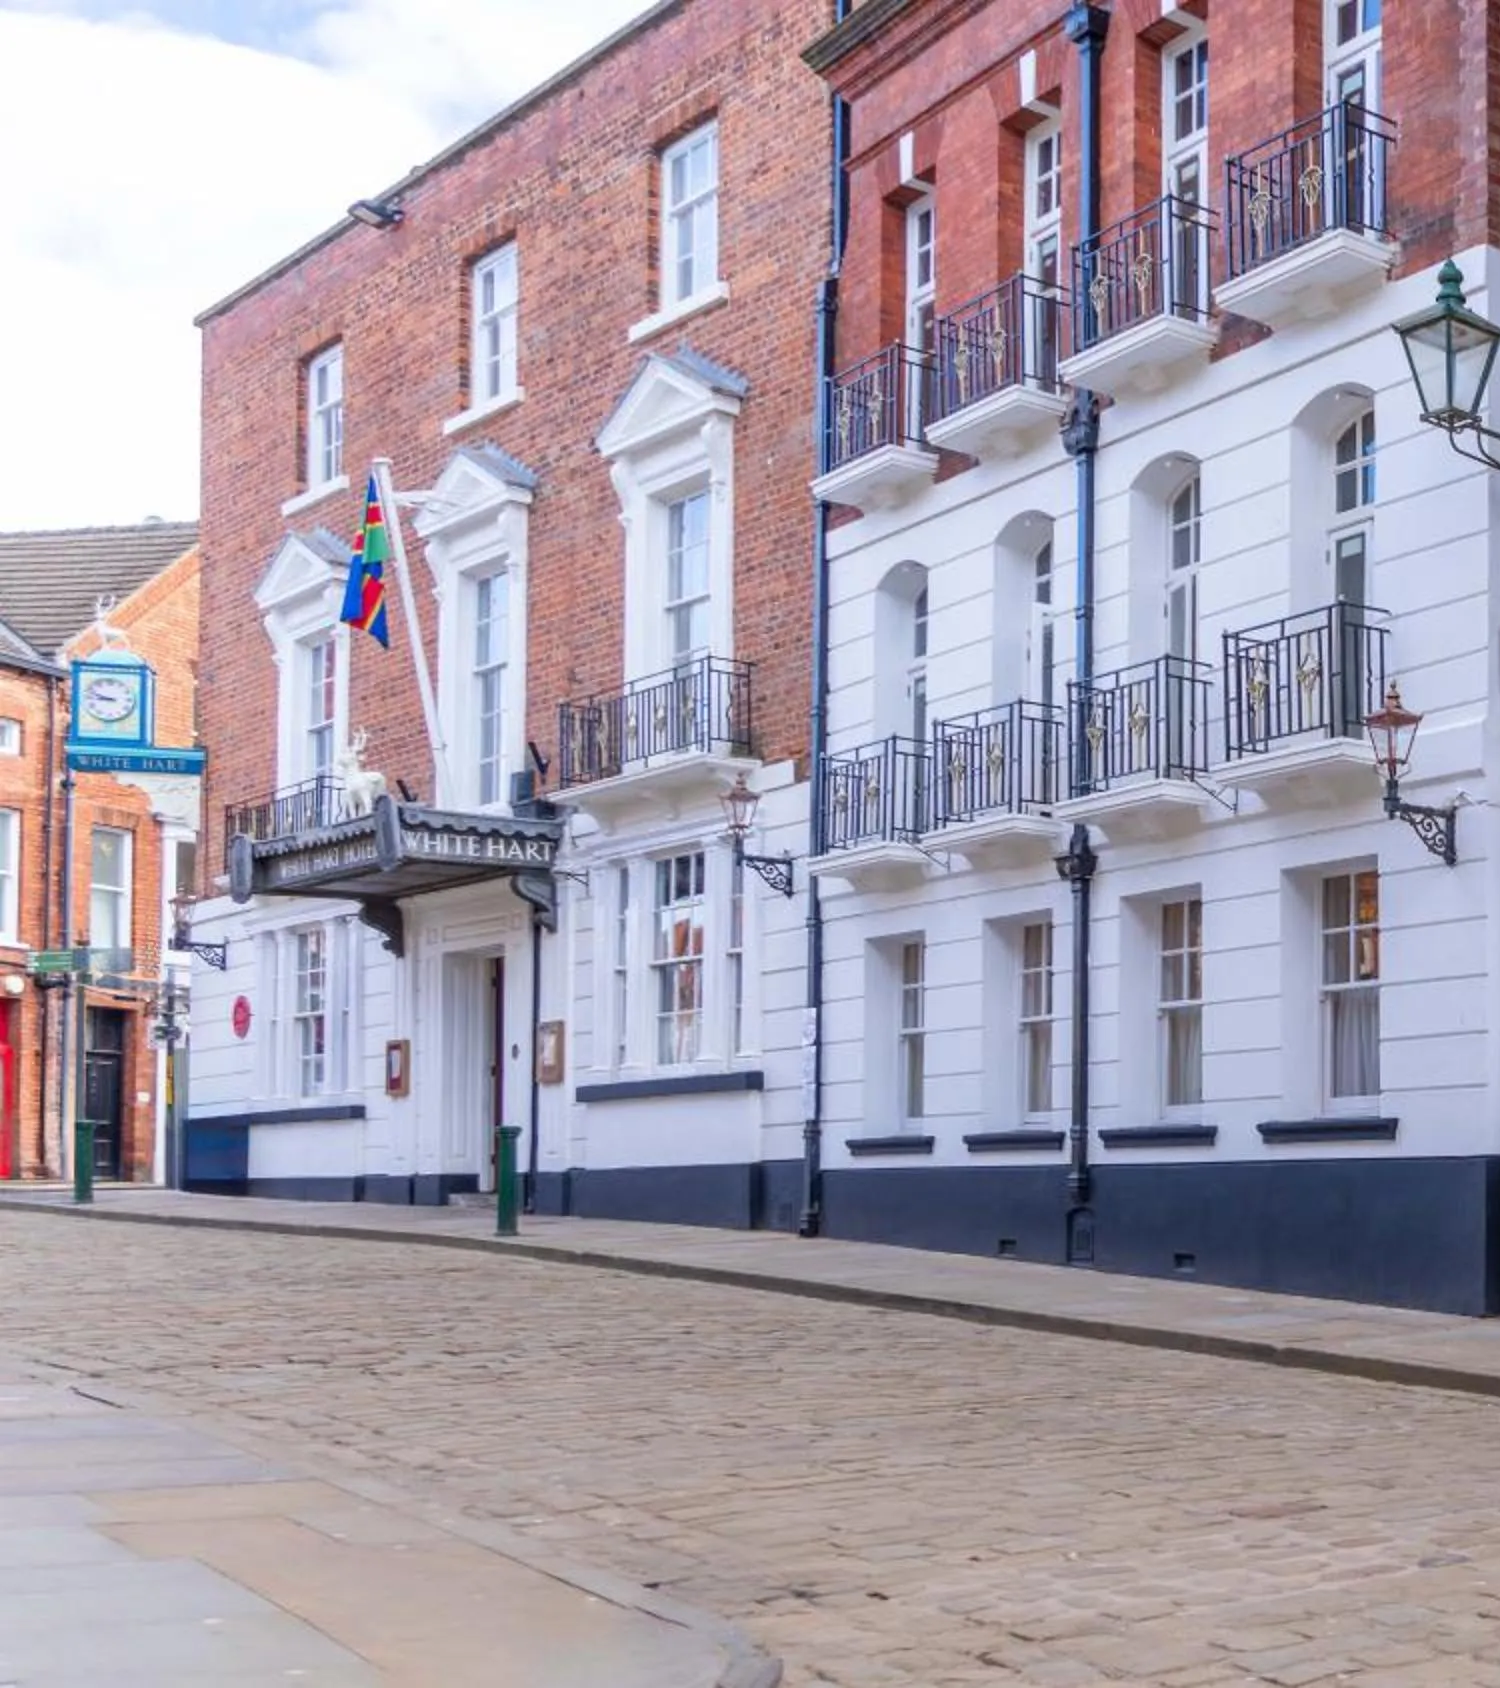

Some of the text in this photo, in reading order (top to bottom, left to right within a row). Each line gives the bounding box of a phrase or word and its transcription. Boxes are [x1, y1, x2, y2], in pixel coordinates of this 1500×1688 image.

[78, 754, 131, 770] WHITE
[400, 830, 555, 862] WHITE HART
